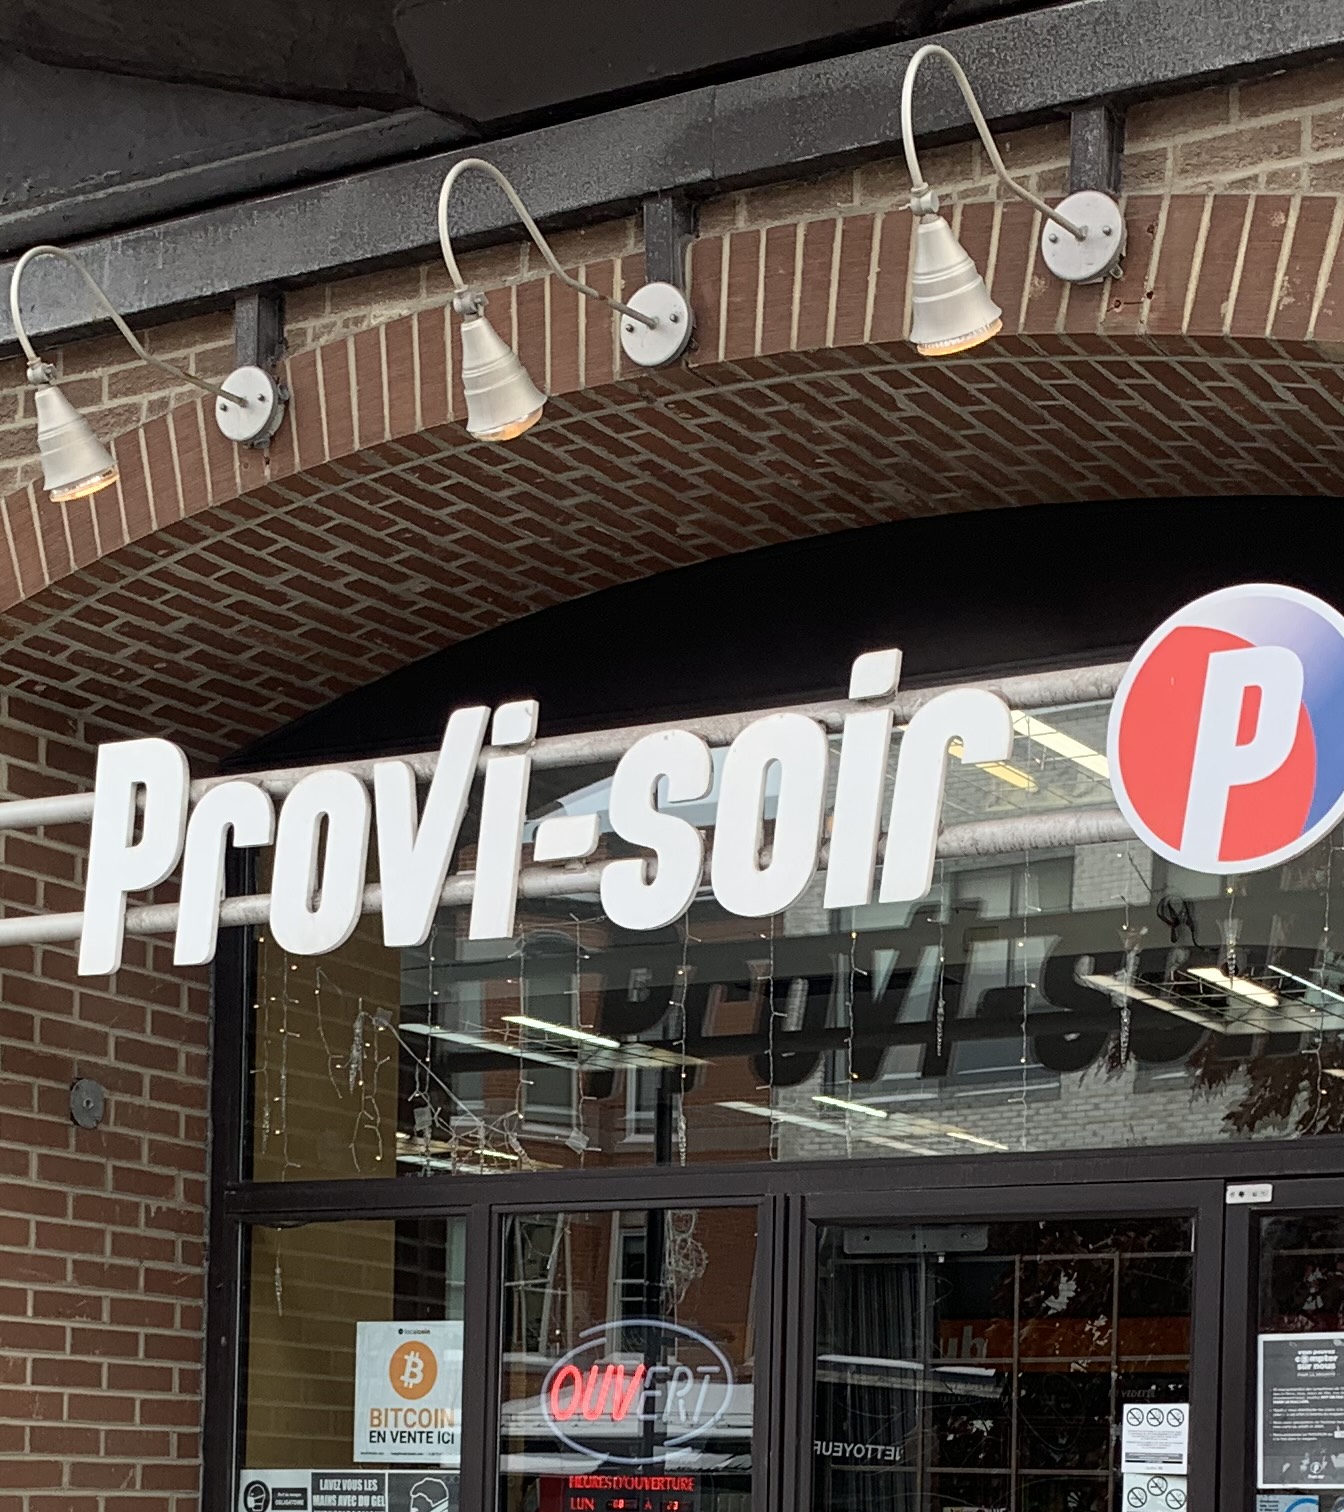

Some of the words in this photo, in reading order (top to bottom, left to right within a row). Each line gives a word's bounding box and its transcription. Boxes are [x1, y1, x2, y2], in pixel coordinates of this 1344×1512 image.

[76, 646, 1012, 977] Provi-soir
[550, 1363, 721, 1424] OUVERT
[369, 1408, 455, 1429] BITCOIN
[369, 1430, 386, 1443] EN
[391, 1431, 434, 1444] VENTE
[438, 1431, 454, 1445] ICI
[320, 1479, 342, 1491] LAVEZ
[342, 1480, 362, 1491] VOUS
[364, 1480, 378, 1492] LES
[312, 1494, 337, 1507] MAINS
[338, 1495, 357, 1507] AVEC
[358, 1495, 370, 1507] DU
[371, 1495, 386, 1508] GEL
[570, 1497, 594, 1511] LUN
